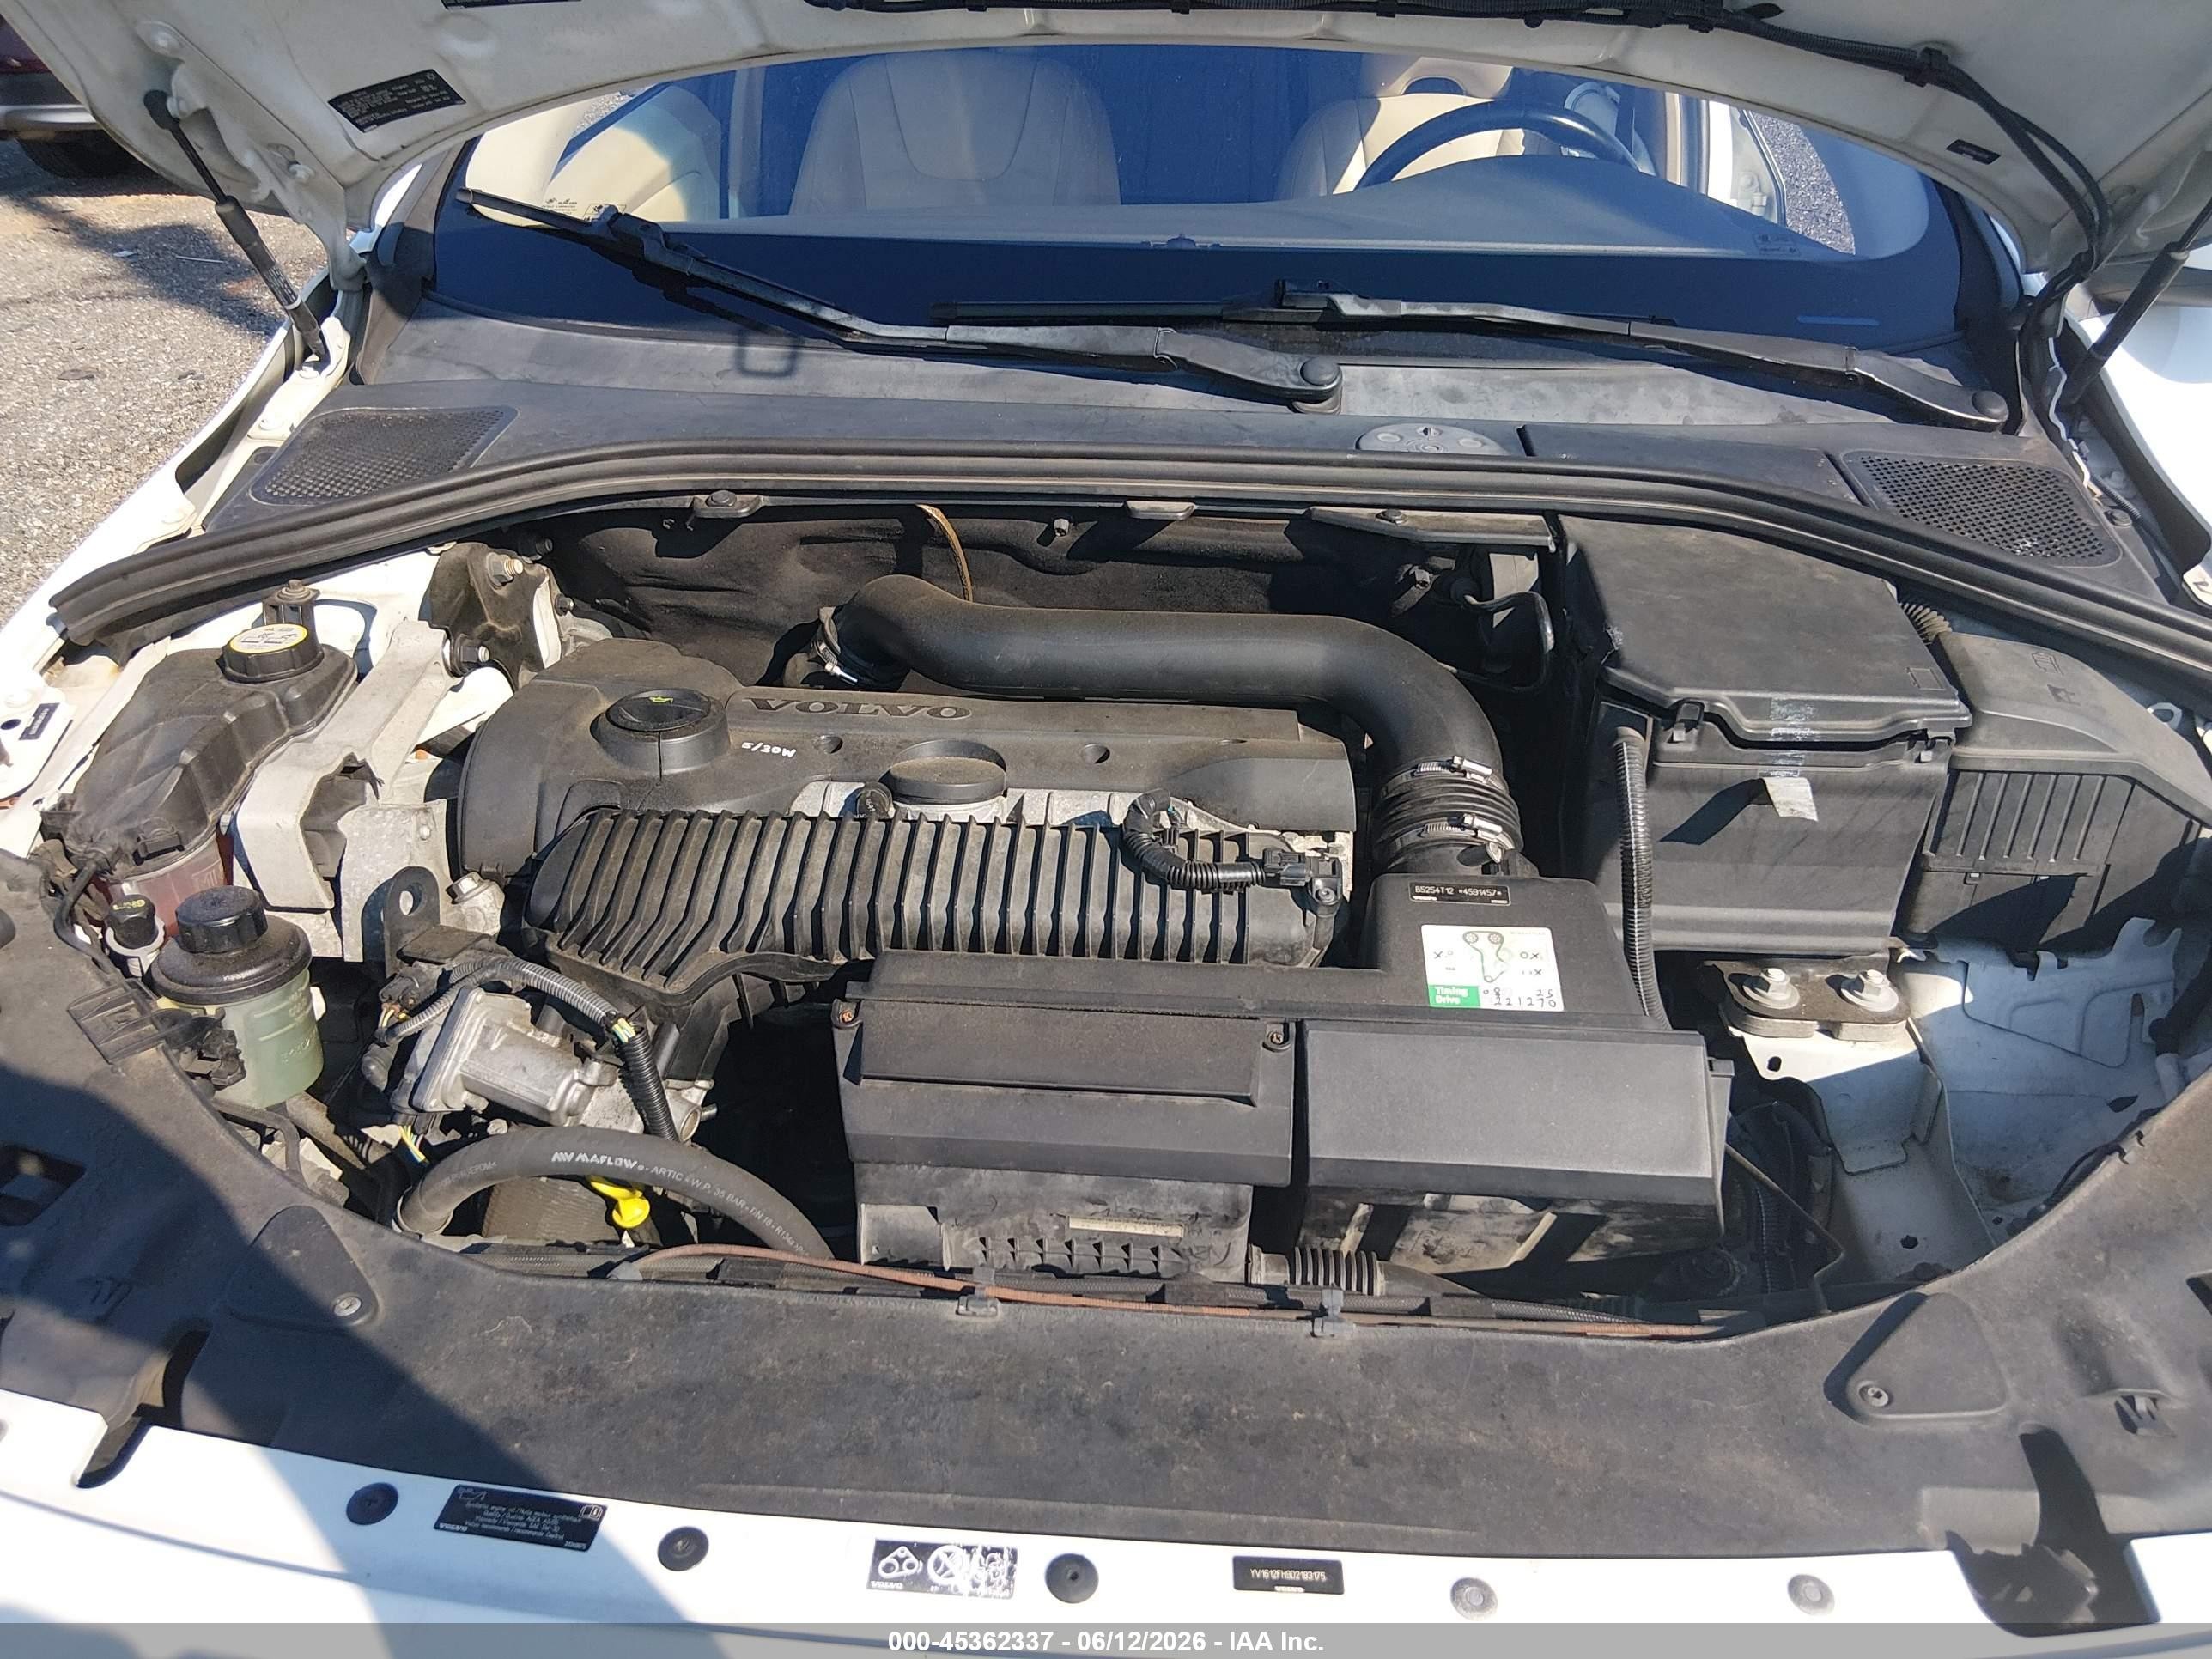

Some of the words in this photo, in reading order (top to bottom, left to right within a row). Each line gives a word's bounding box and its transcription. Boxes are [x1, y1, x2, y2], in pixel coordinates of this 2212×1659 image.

[744, 697, 971, 719] VOLVO
[1414, 885, 1455, 895] B5254T12
[1435, 987, 1469, 998] Timing
[1435, 996, 1461, 1005] Drive
[574, 1152, 638, 1169] MAFLOW
[651, 1166, 684, 1182] ARTIC
[871, 1581, 903, 1589] VOLVO
